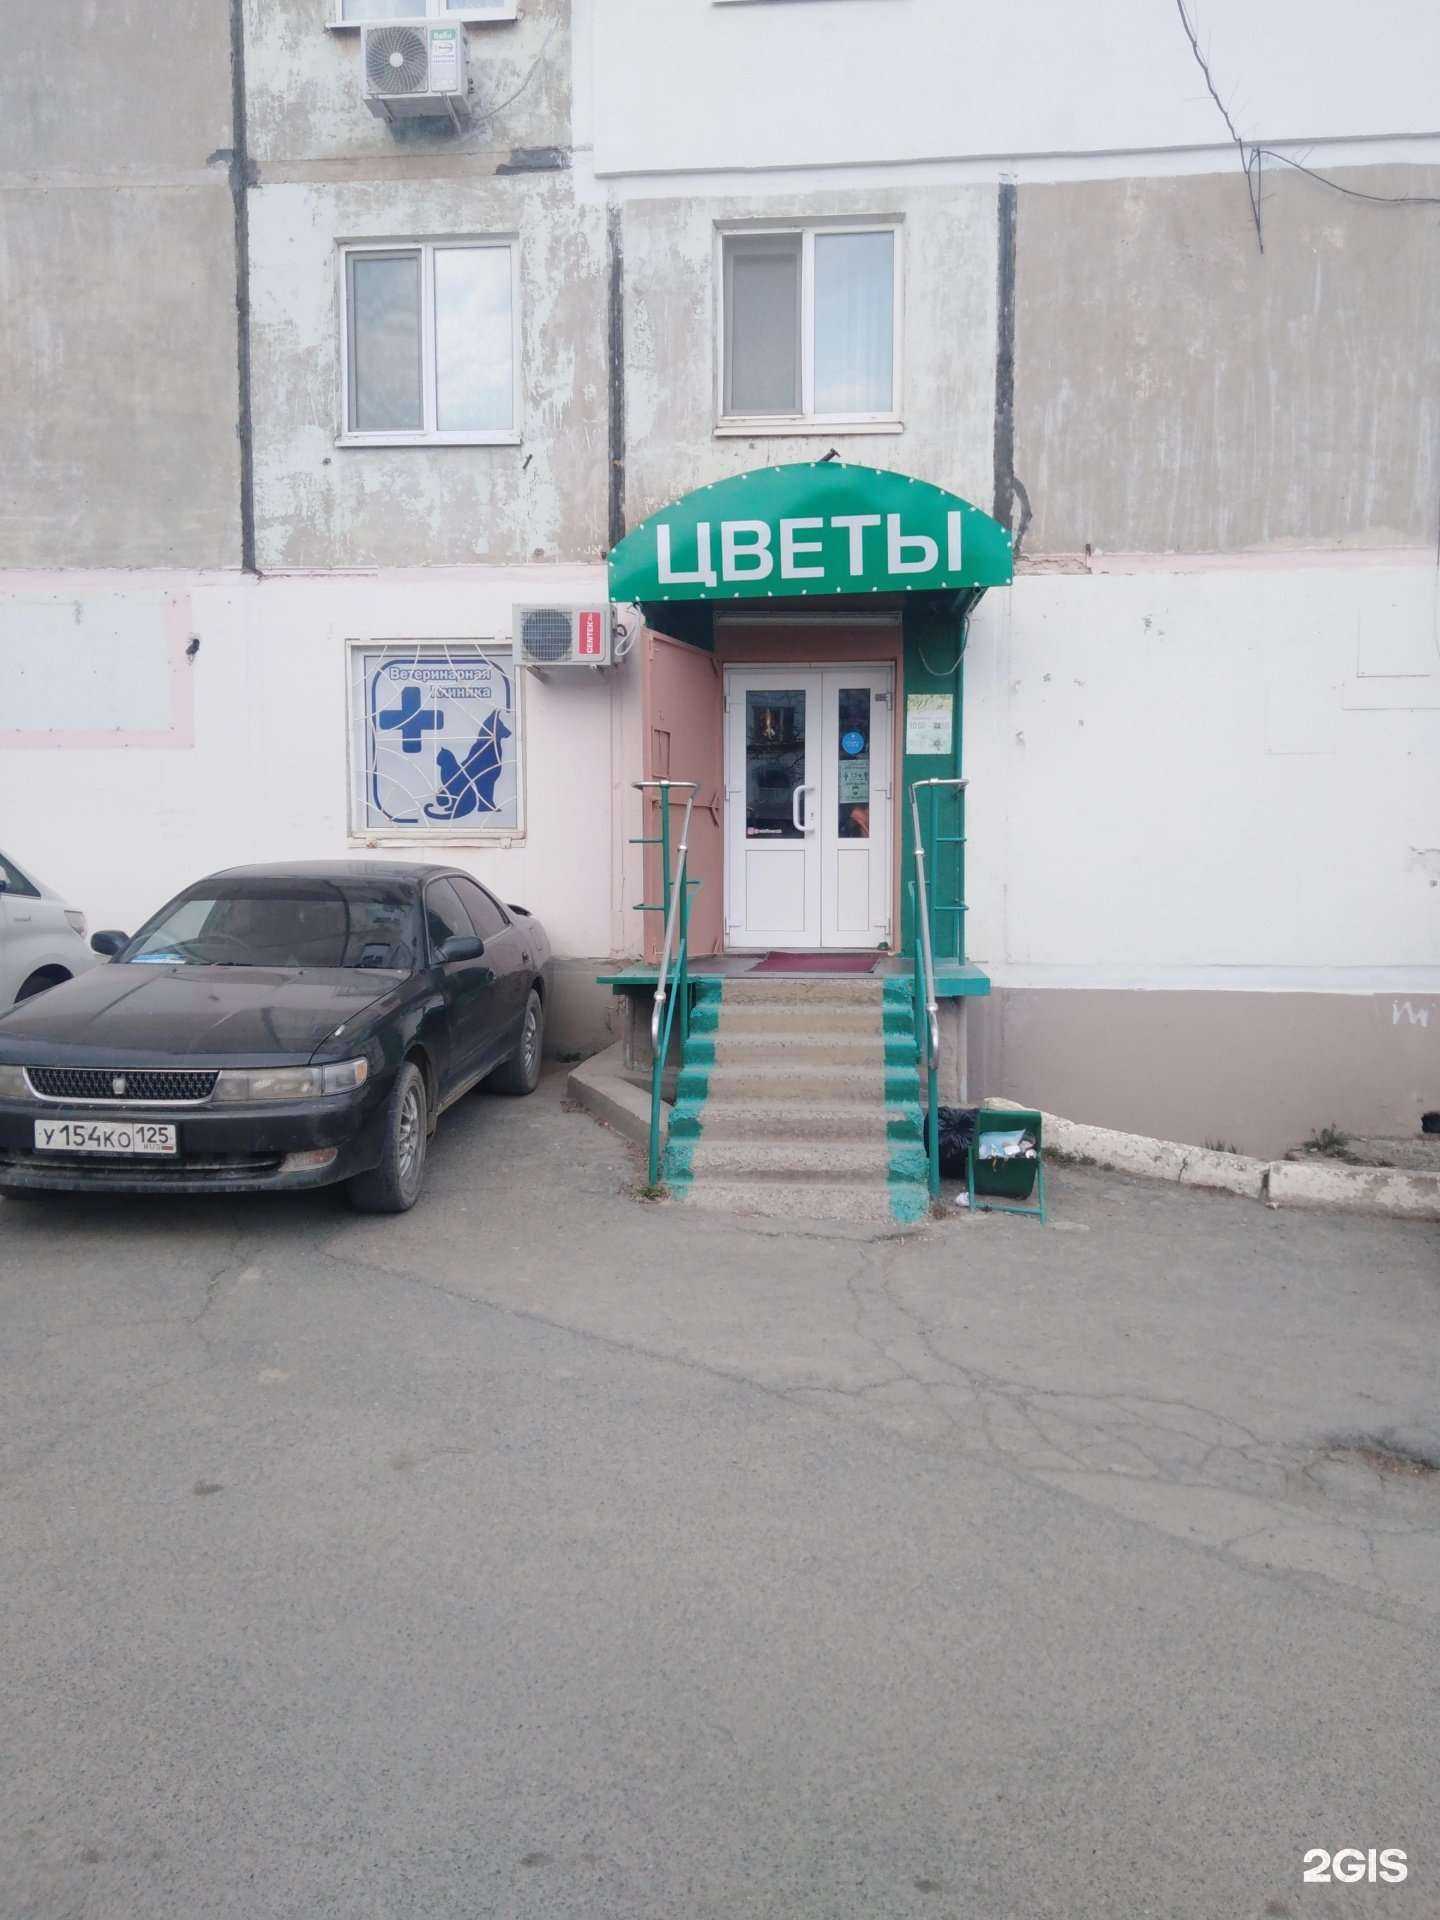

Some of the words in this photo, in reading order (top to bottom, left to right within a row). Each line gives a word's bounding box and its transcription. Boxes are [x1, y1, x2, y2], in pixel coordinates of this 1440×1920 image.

[656, 510, 963, 588] ЦВЕТЫ
[389, 667, 492, 682] Ветеринарная
[136, 1126, 169, 1144] 125
